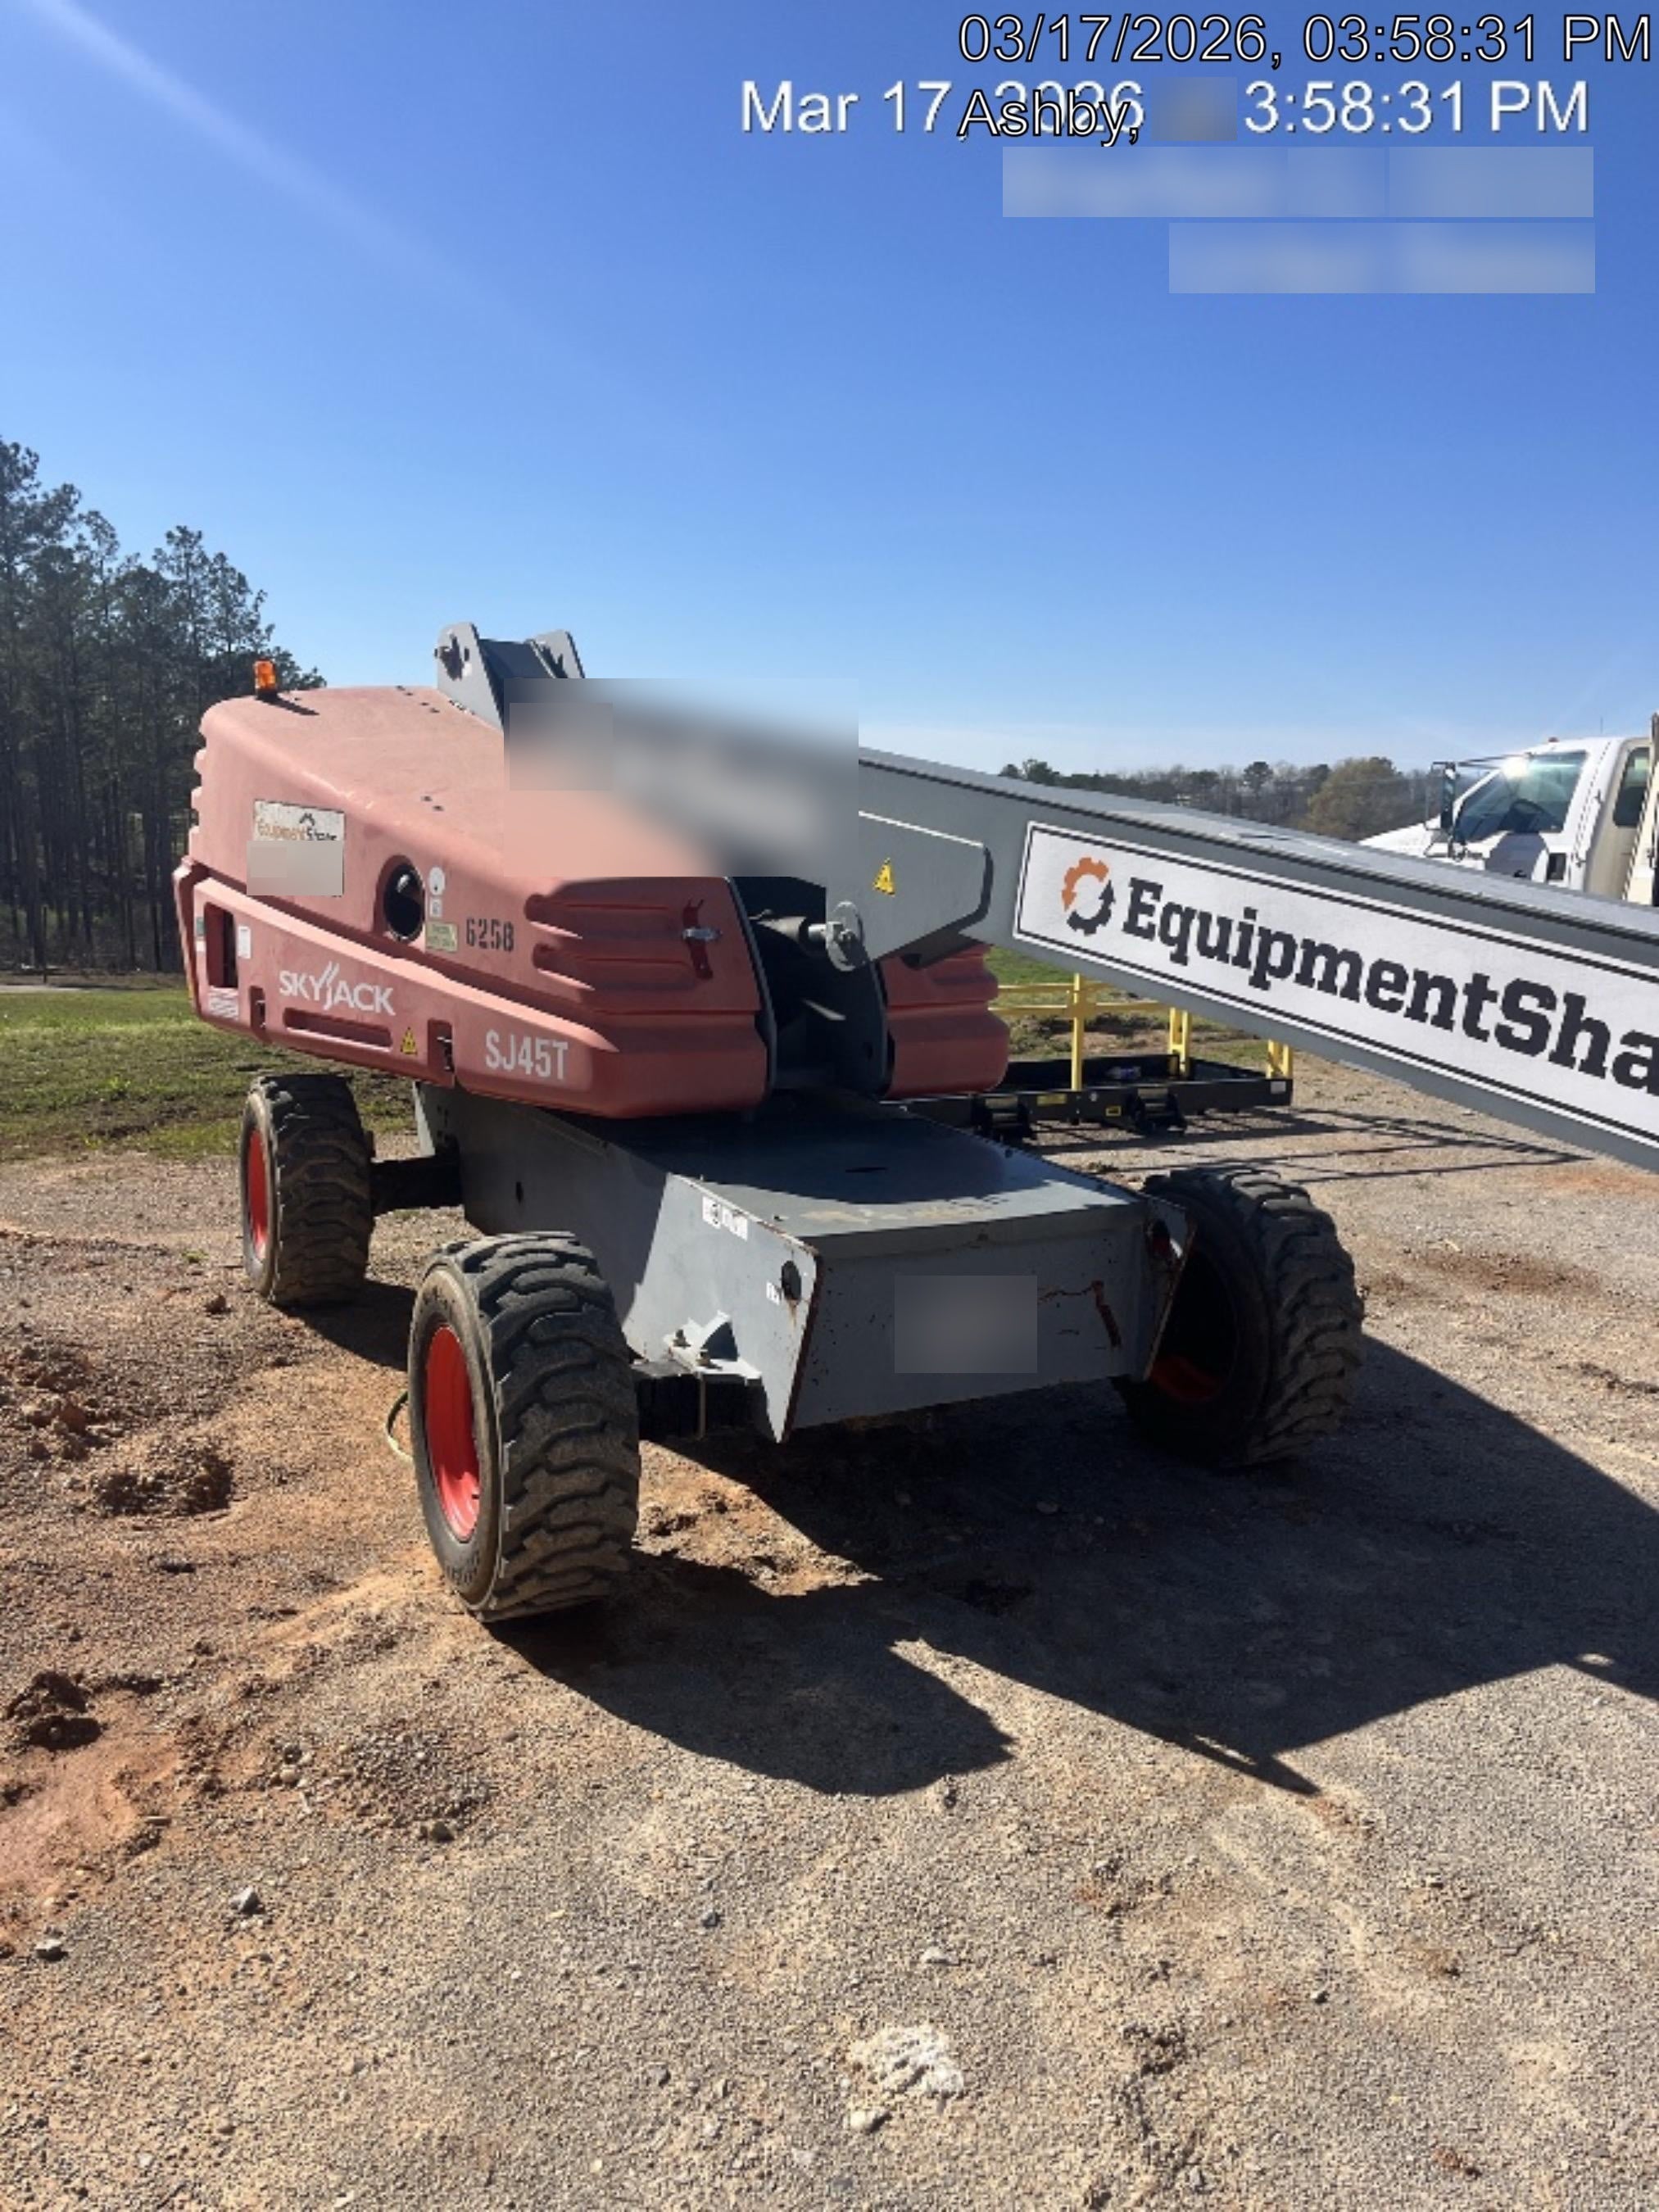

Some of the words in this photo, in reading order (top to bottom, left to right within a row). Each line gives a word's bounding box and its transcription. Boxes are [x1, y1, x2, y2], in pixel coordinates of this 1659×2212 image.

[466, 918, 514, 952] 6258
[279, 961, 395, 1015] SKYJACK
[485, 1029, 569, 1080] SJ45T
